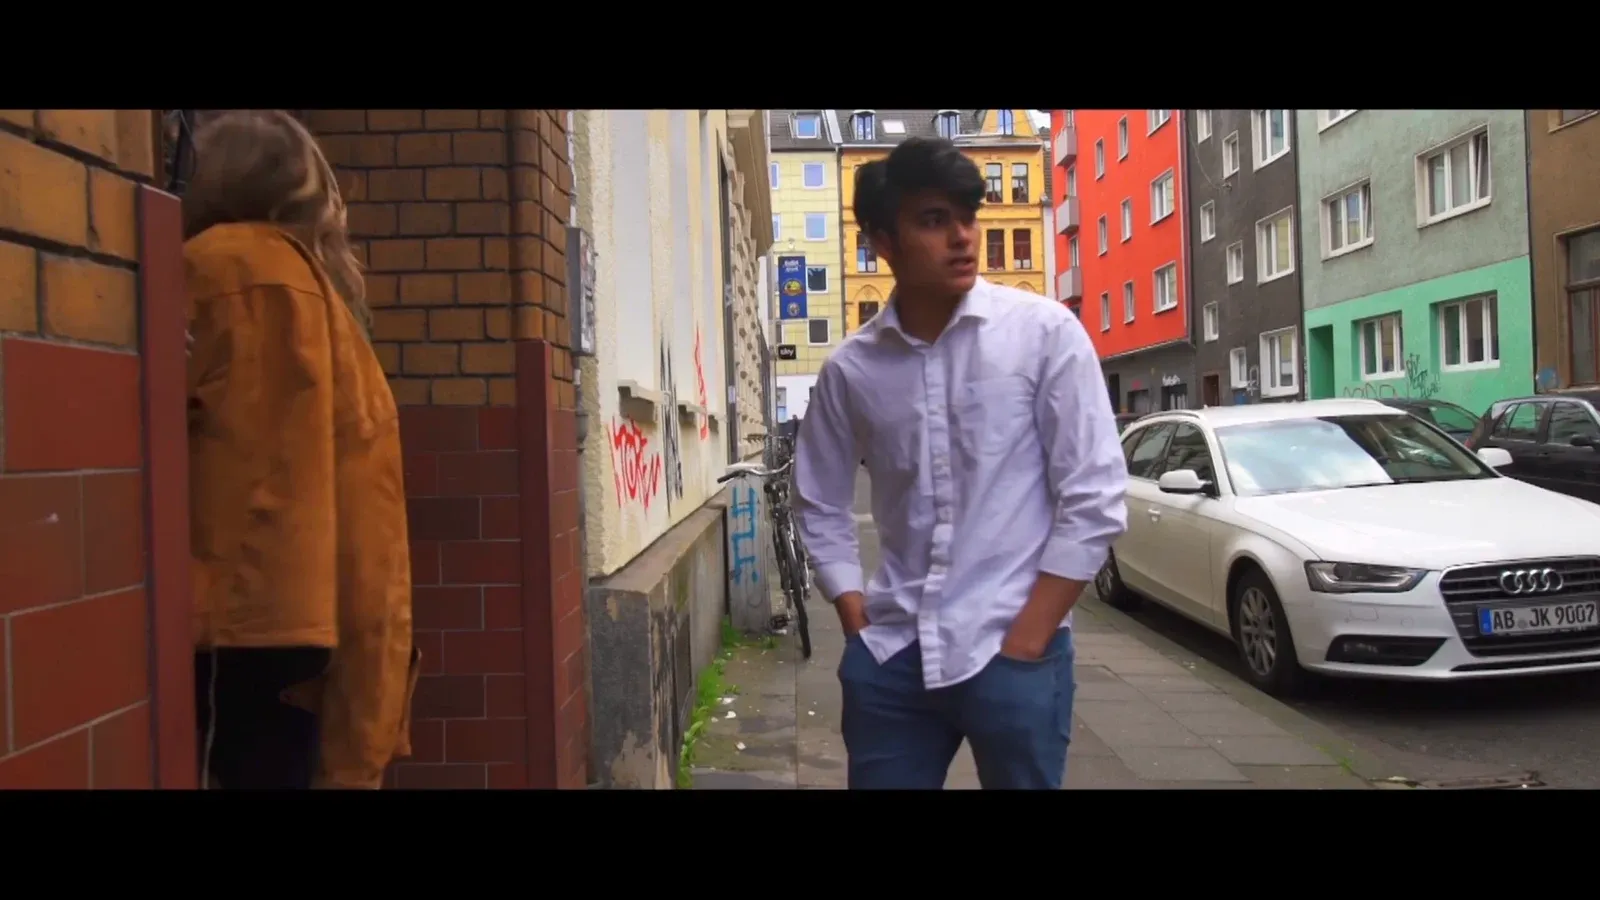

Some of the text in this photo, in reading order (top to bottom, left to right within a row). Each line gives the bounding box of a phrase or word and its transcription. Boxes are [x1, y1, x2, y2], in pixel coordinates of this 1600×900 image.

[780, 347, 794, 357] sky
[1493, 603, 1595, 630] AB JK 9007
